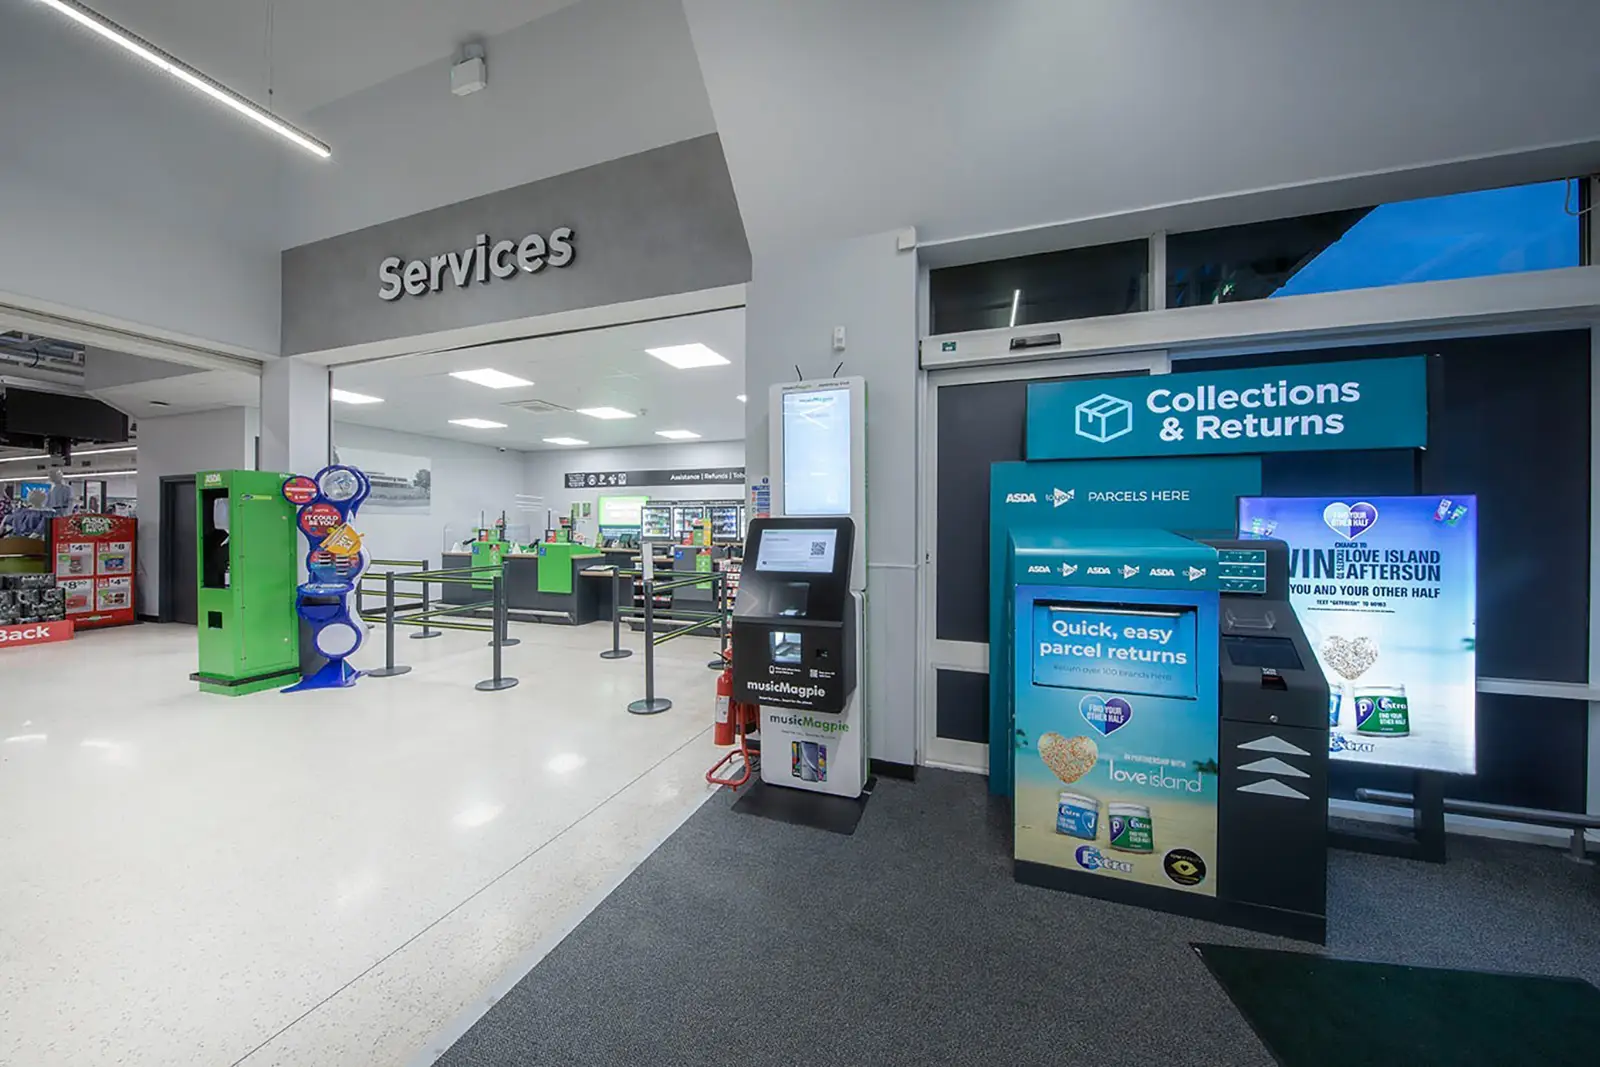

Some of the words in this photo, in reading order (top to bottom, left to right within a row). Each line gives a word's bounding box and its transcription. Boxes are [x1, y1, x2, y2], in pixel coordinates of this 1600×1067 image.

[378, 227, 575, 301] Services
[1146, 380, 1361, 414] Collections
[1159, 417, 1185, 442] &
[1196, 413, 1345, 440] Returns
[1006, 493, 1037, 503] ASDA
[1088, 490, 1148, 502] PARCELS
[1151, 490, 1190, 501] HERE
[1345, 549, 1380, 563] LOVE
[1385, 549, 1440, 564] ISLAND
[1027, 565, 1052, 574] ASDA
[1086, 566, 1111, 575] ASDA
[1149, 568, 1175, 577] ASDA
[1346, 563, 1441, 582] AFTERSUN
[1289, 584, 1311, 595] YOU
[1313, 584, 1337, 596] AND
[1339, 585, 1369, 597] YOUR
[1372, 586, 1408, 598] OTHER
[1411, 587, 1441, 599] HALF
[1052, 620, 1118, 640] Quick,
[1123, 627, 1173, 644] easy
[1040, 642, 1101, 657] parcel
[1108, 646, 1187, 665] returns
[1053, 664, 1082, 673] Return
[1083, 666, 1100, 674] over
[1102, 668, 1118, 676] 100
[1118, 669, 1150, 679] brands
[1151, 672, 1172, 681] here
[747, 680, 826, 698] musicMagpie
[1087, 711, 1107, 721] OTHER
[1108, 714, 1125, 724] HALF
[1088, 704, 1104, 713] FIND
[1105, 706, 1122, 715] YOUR
[1359, 702, 1368, 717] P
[770, 714, 849, 732] musicMagpie
[1109, 758, 1147, 785] love
[1149, 765, 1202, 792] island
[1087, 817, 1095, 829] J
[1113, 821, 1120, 833] P
[1081, 849, 1134, 873] Extra
